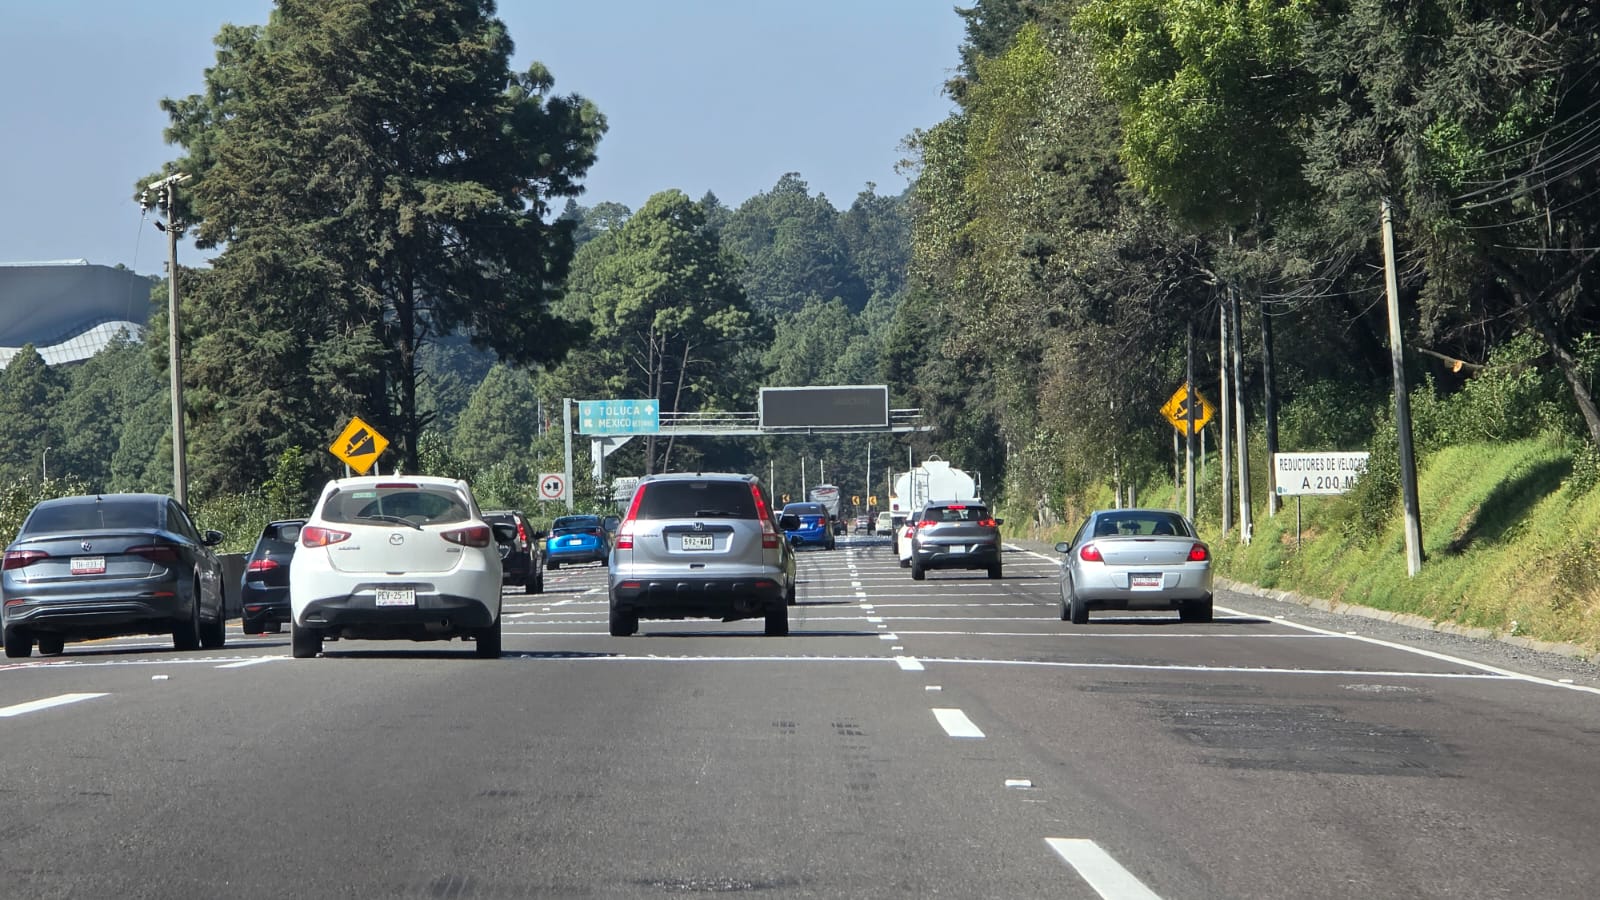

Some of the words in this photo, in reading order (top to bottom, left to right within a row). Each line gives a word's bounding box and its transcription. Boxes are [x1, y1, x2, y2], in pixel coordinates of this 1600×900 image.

[600, 406, 640, 416] TOLUCA
[1280, 458, 1324, 471] REDUCTORES
[1326, 458, 1336, 471] DE
[1302, 476, 1311, 489] A
[1316, 476, 1340, 489] 200
[377, 591, 413, 600] PEV-25-11
